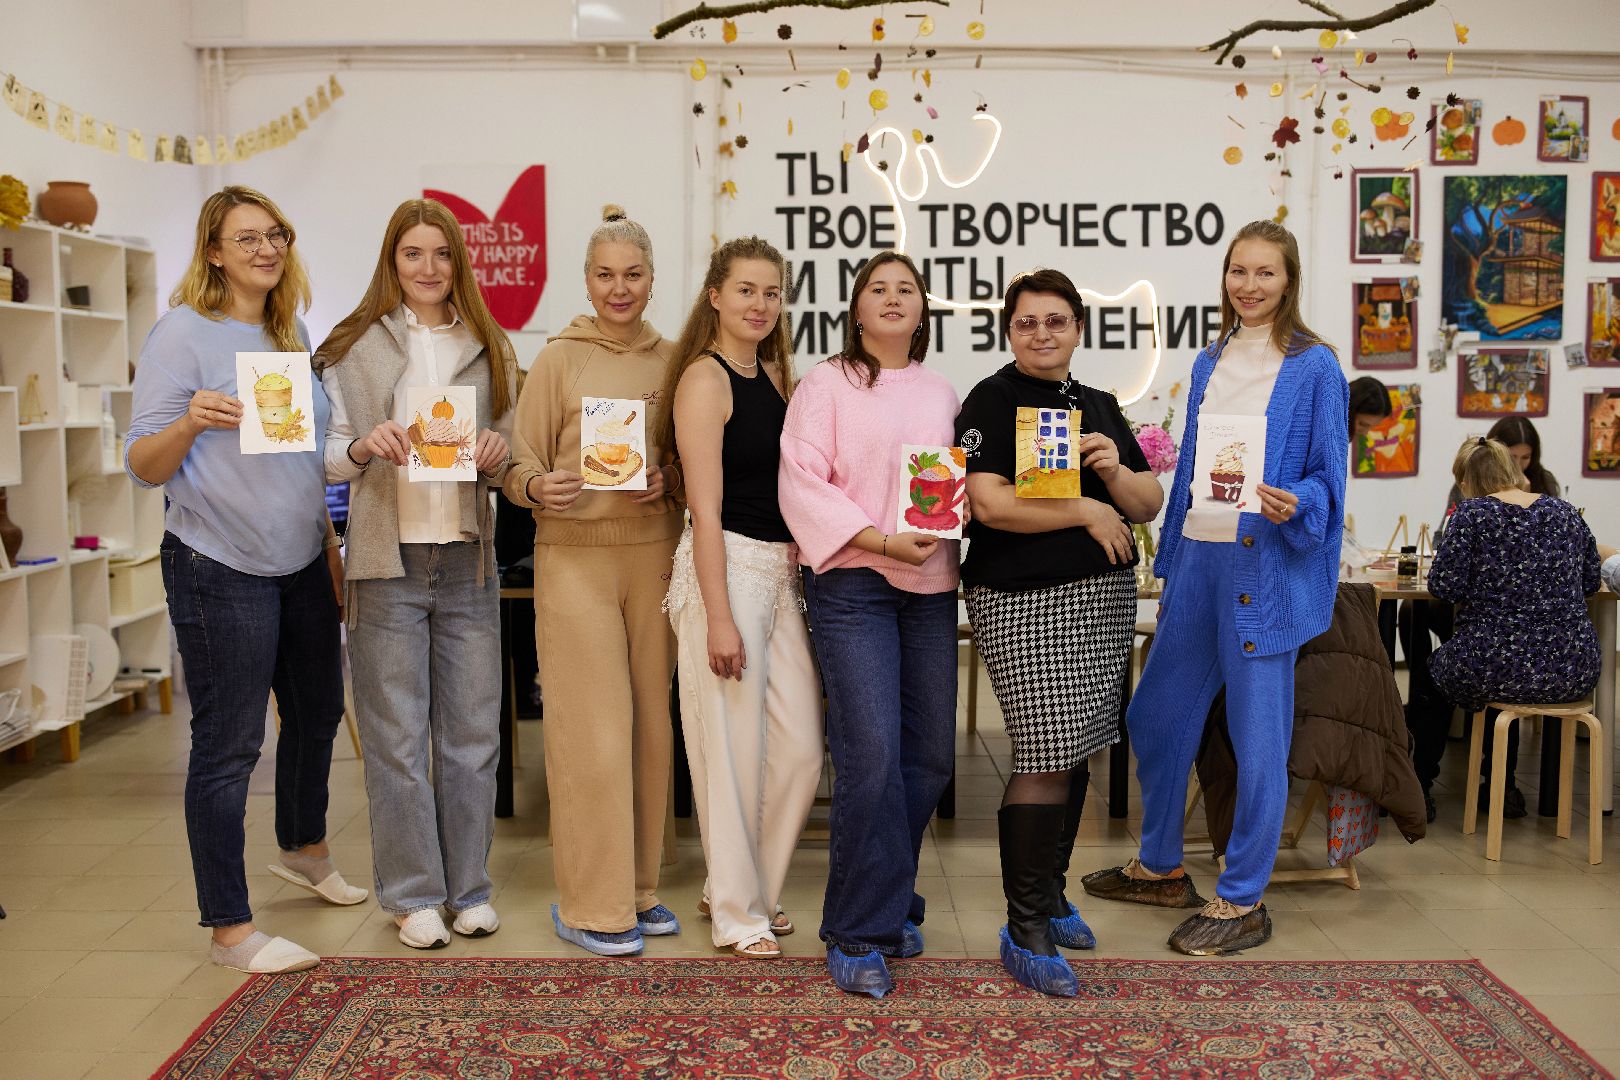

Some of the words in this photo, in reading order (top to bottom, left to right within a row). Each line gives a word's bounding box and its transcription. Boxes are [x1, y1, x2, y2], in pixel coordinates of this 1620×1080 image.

[776, 152, 848, 196] ТЫ
[460, 222, 498, 244] THIS
[500, 221, 525, 242] IS
[776, 205, 896, 250] ТВОЕ
[918, 202, 1224, 248] ТВОРЧЕСТВО
[483, 243, 539, 265] HAPPY
[786, 260, 816, 304] И
[838, 256, 1005, 302] МТЫ
[787, 309, 954, 355] ИМТ
